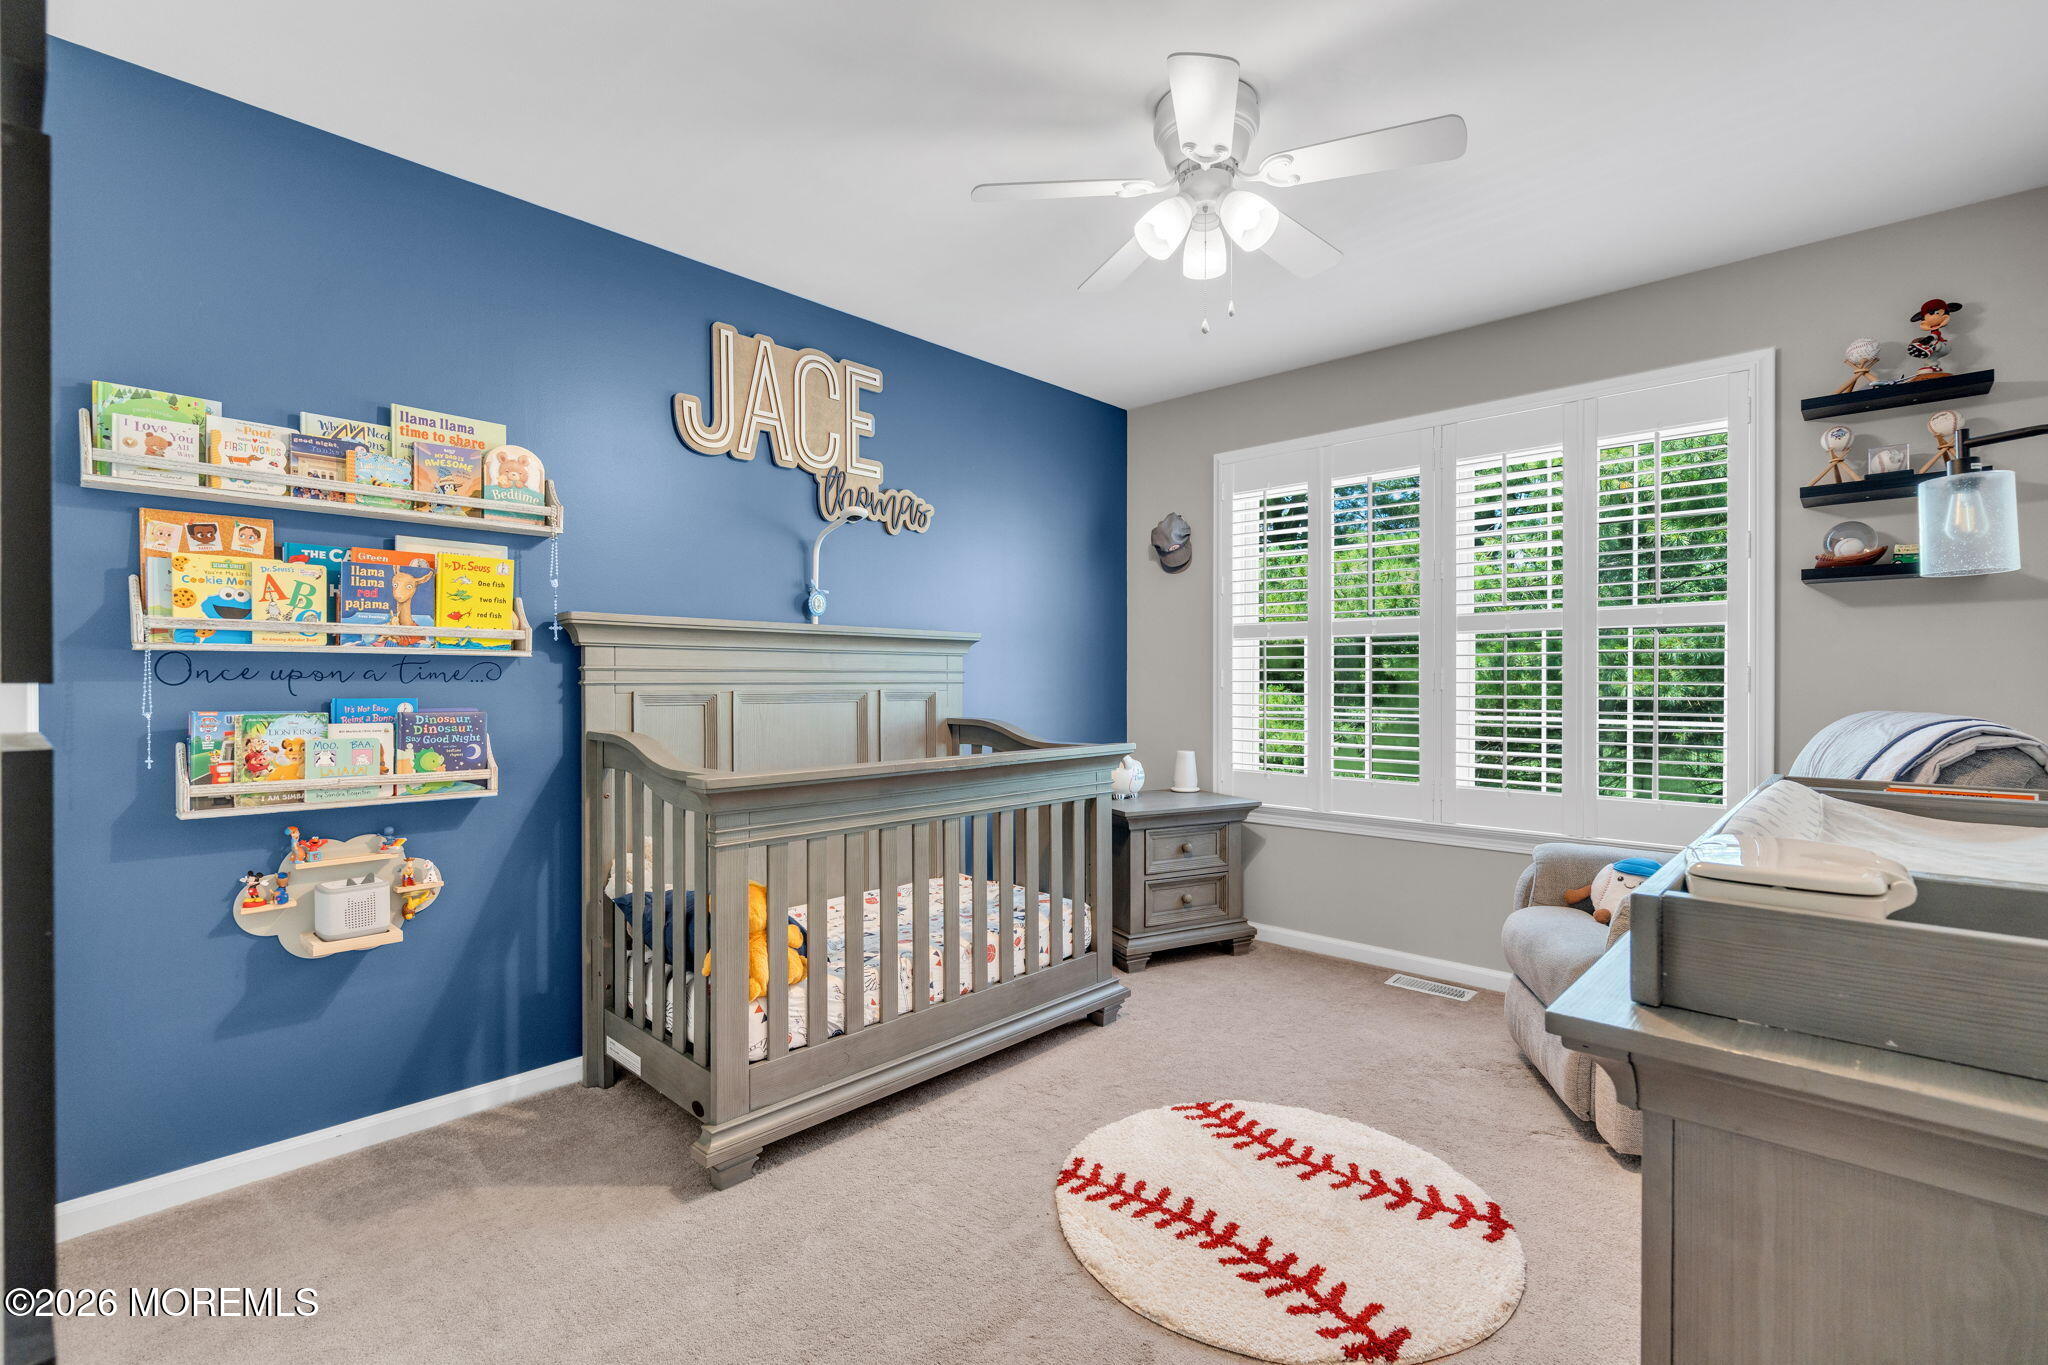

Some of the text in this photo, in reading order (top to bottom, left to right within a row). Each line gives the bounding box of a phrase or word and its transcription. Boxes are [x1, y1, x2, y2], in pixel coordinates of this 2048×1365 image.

[681, 327, 882, 480] JACE
[124, 418, 167, 433] I Love
[399, 411, 475, 435] llama llama
[170, 433, 194, 444] You
[367, 427, 390, 441] Need
[399, 425, 486, 450] time to share
[224, 441, 281, 457] FIRST WORDS
[177, 451, 195, 459] Ways
[424, 459, 474, 472] AWESOME
[492, 488, 540, 504] Bedtime
[820, 465, 932, 530] thomas
[301, 549, 327, 560] THE
[357, 551, 389, 562] Green
[272, 565, 295, 573] Seuss's
[350, 565, 385, 577] llama
[452, 561, 466, 572] Dr.
[467, 561, 492, 574] Seuss
[181, 574, 223, 585] Cookie
[350, 576, 385, 588] llama
[477, 580, 506, 588] One fish
[357, 587, 379, 598] red
[345, 598, 390, 611] pajama
[493, 597, 507, 605] fish
[489, 611, 502, 619] fish
[154, 651, 258, 686] Once
[270, 667, 354, 697] upon
[363, 668, 387, 683] a
[344, 704, 389, 714] It's Not Easy
[340, 716, 364, 724] Being
[268, 727, 317, 736] LION KING
[405, 733, 481, 744] Say Good Night
